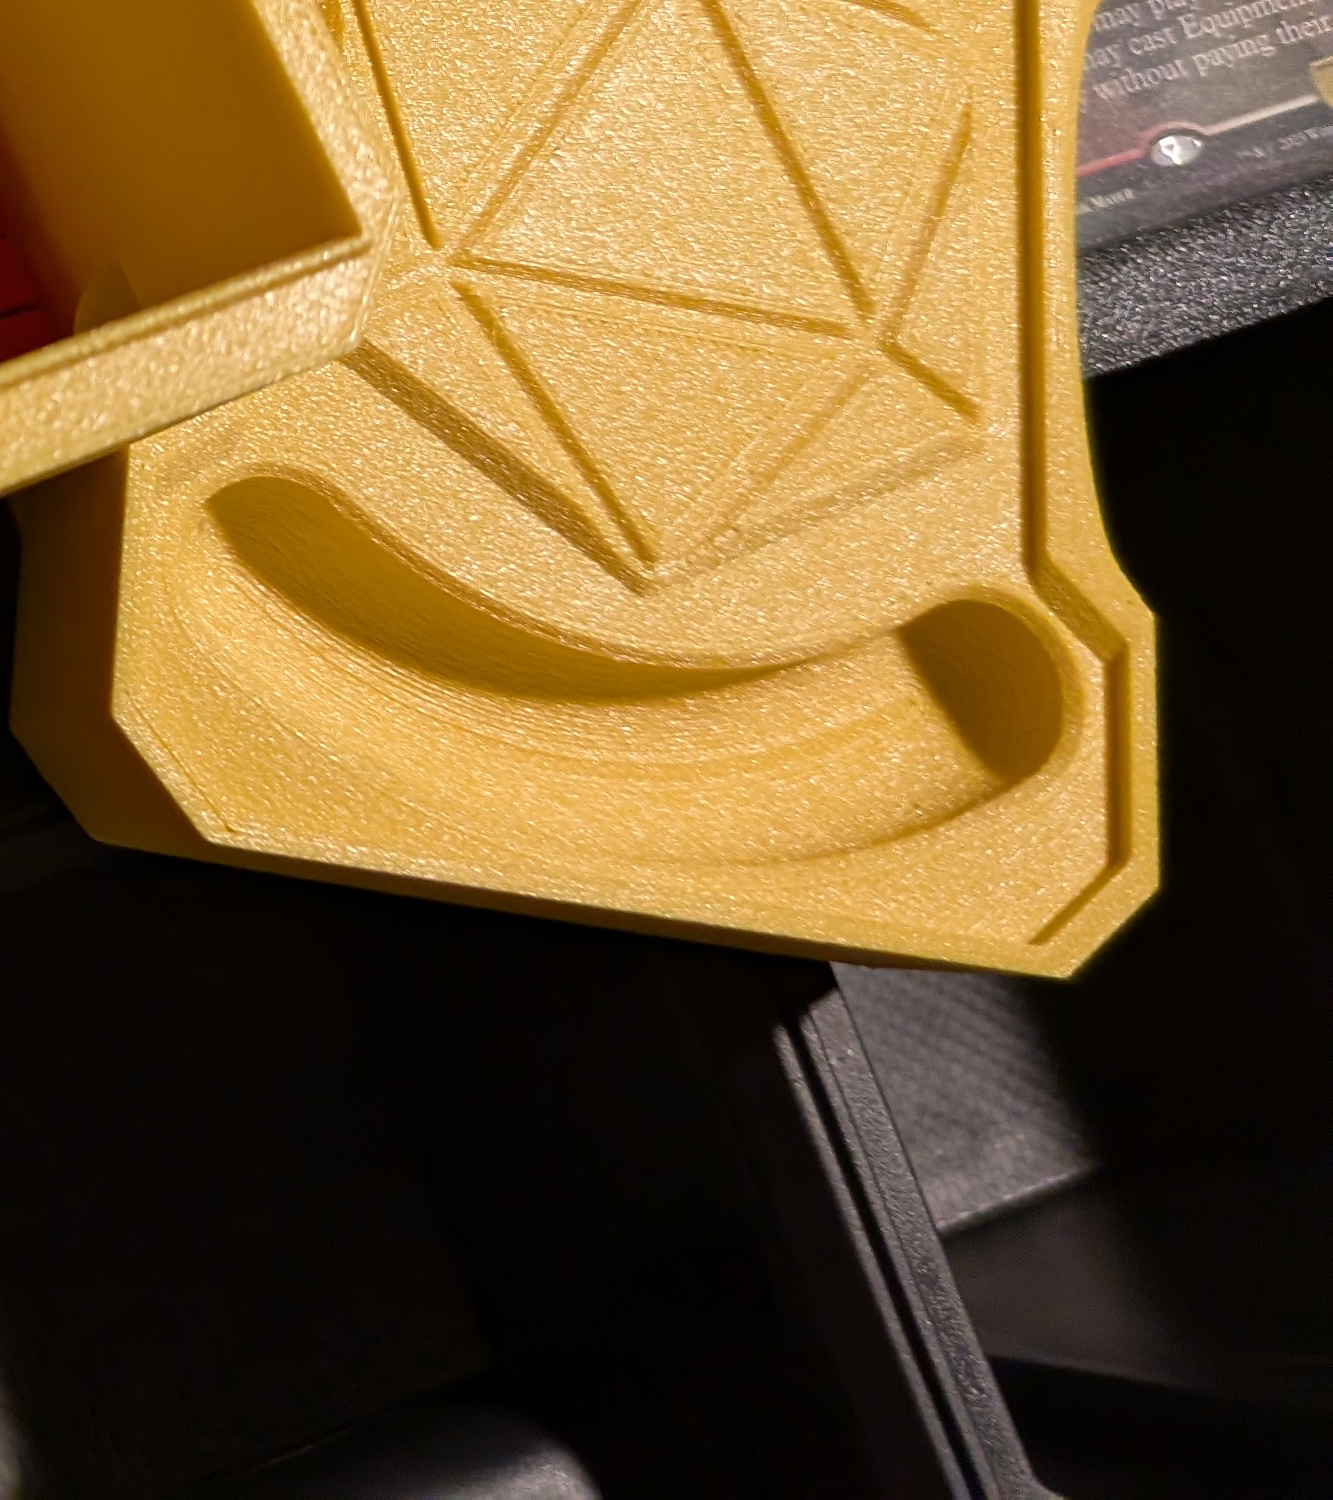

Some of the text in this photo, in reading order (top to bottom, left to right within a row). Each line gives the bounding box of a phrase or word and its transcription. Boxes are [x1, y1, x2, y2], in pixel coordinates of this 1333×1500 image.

[1093, 3, 1142, 32] may
[1129, 28, 1177, 55] cast
[1093, 13, 1330, 101] without paying their
